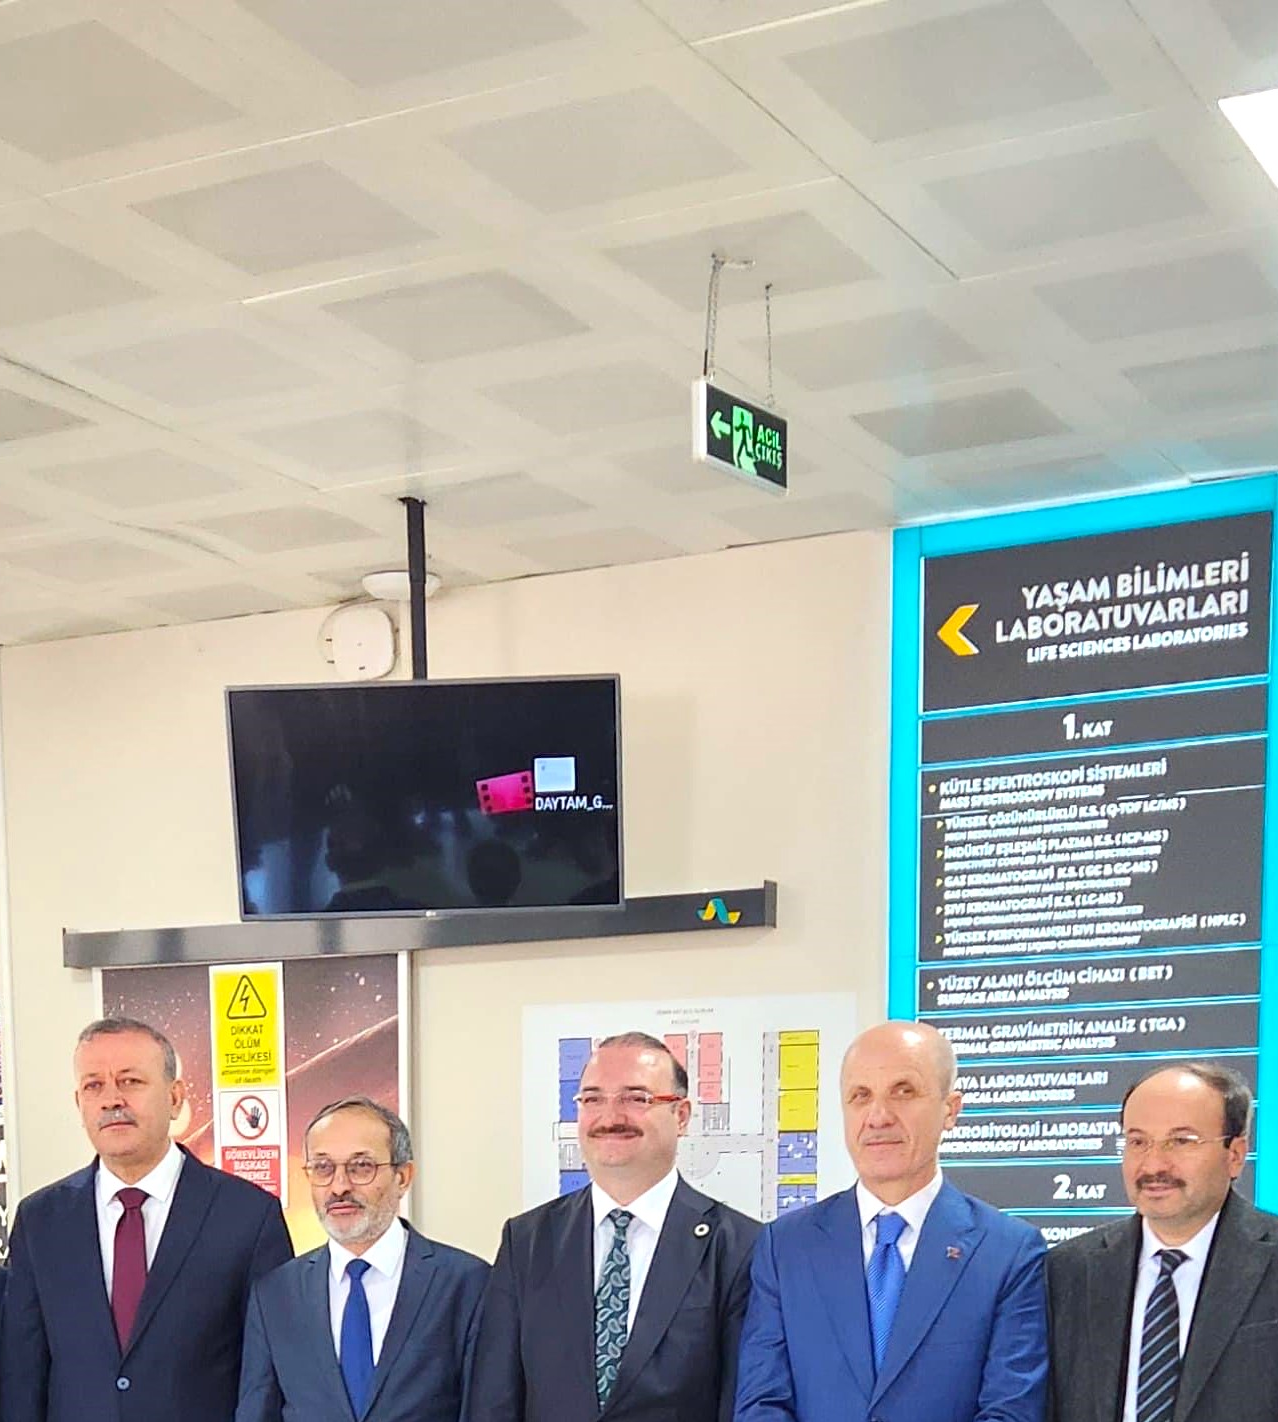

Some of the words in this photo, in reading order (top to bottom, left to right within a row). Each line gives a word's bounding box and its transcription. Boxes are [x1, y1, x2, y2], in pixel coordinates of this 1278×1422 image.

[1022, 576, 1111, 612] YAŞAM
[1117, 551, 1249, 598] BİLİMLERİ
[995, 589, 1249, 643] LABORATUVARLARI
[1027, 644, 1058, 663] LIFE
[1058, 635, 1132, 660] SCIENCES
[1132, 621, 1249, 651] LABORATORIES
[1062, 713, 1081, 741] 1.
[1082, 719, 1114, 739] KAT
[939, 776, 982, 797] KÜTLE
[982, 763, 1086, 793] SPEKTROSKOPİ
[1085, 756, 1168, 783] SİSTEMLERİ
[937, 974, 982, 992] YÜZEY
[981, 972, 1024, 990] ALANI
[1024, 967, 1076, 988] ÖLÇÜM
[1076, 966, 1126, 985] CİHAZI
[230, 1023, 263, 1036] DİKKAT
[1084, 1015, 1137, 1034] ANALİZ
[234, 1036, 261, 1049] ÖLÜM
[224, 1050, 271, 1064] TEHLİKESİ
[979, 1071, 1109, 1089] LABORATUVARLARI
[1052, 1173, 1075, 1200] 2.
[1076, 1184, 1108, 1200] KAT
